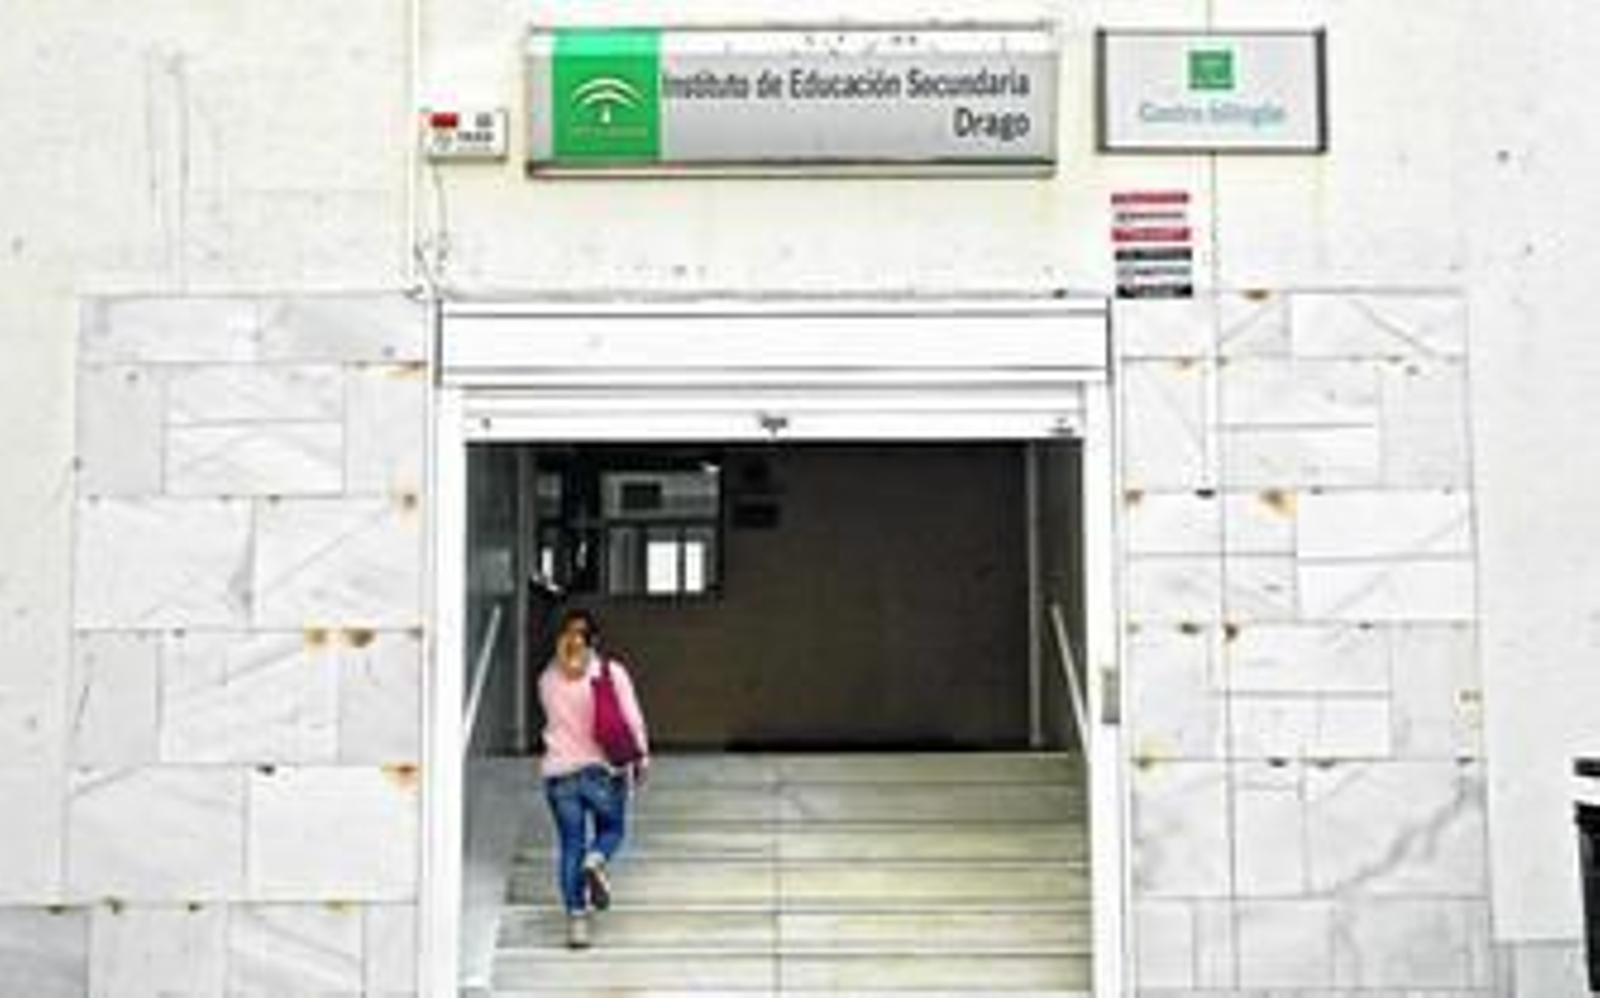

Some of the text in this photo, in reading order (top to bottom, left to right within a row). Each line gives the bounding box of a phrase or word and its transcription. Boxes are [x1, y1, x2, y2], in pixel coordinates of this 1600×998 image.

[662, 67, 1030, 99] Instituto de Educación Secundaria
[954, 106, 1030, 142] Drago
